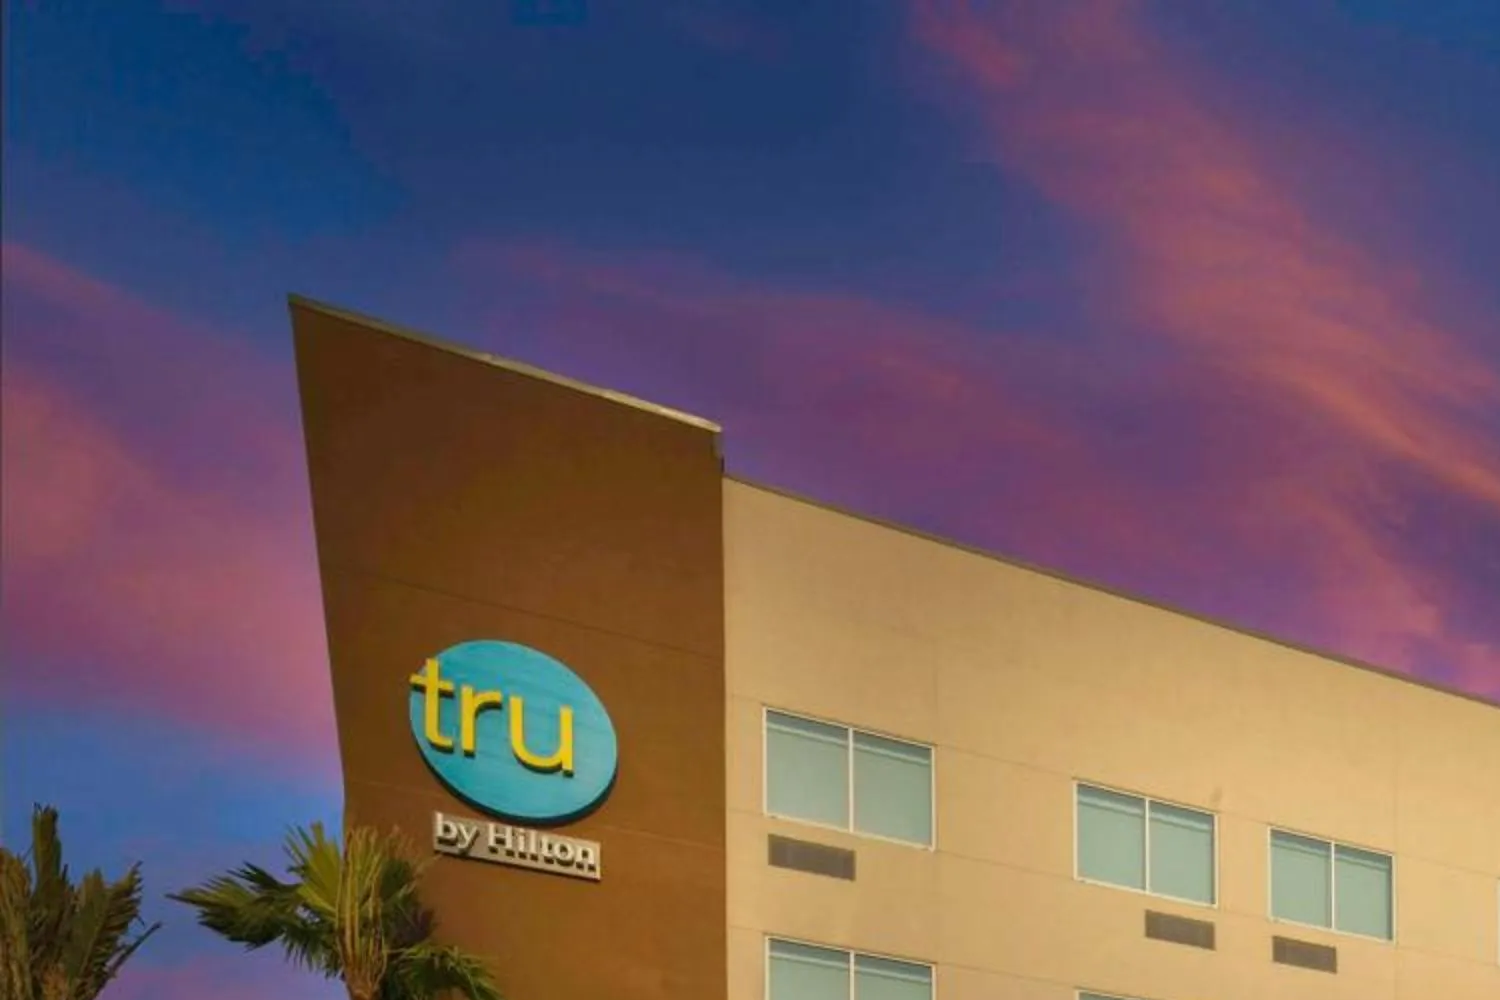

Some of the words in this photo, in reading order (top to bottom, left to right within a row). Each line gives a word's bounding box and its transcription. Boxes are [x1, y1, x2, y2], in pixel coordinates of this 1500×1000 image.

[410, 657, 574, 774] tru
[434, 811, 478, 849] by
[488, 823, 595, 866] Hilton
